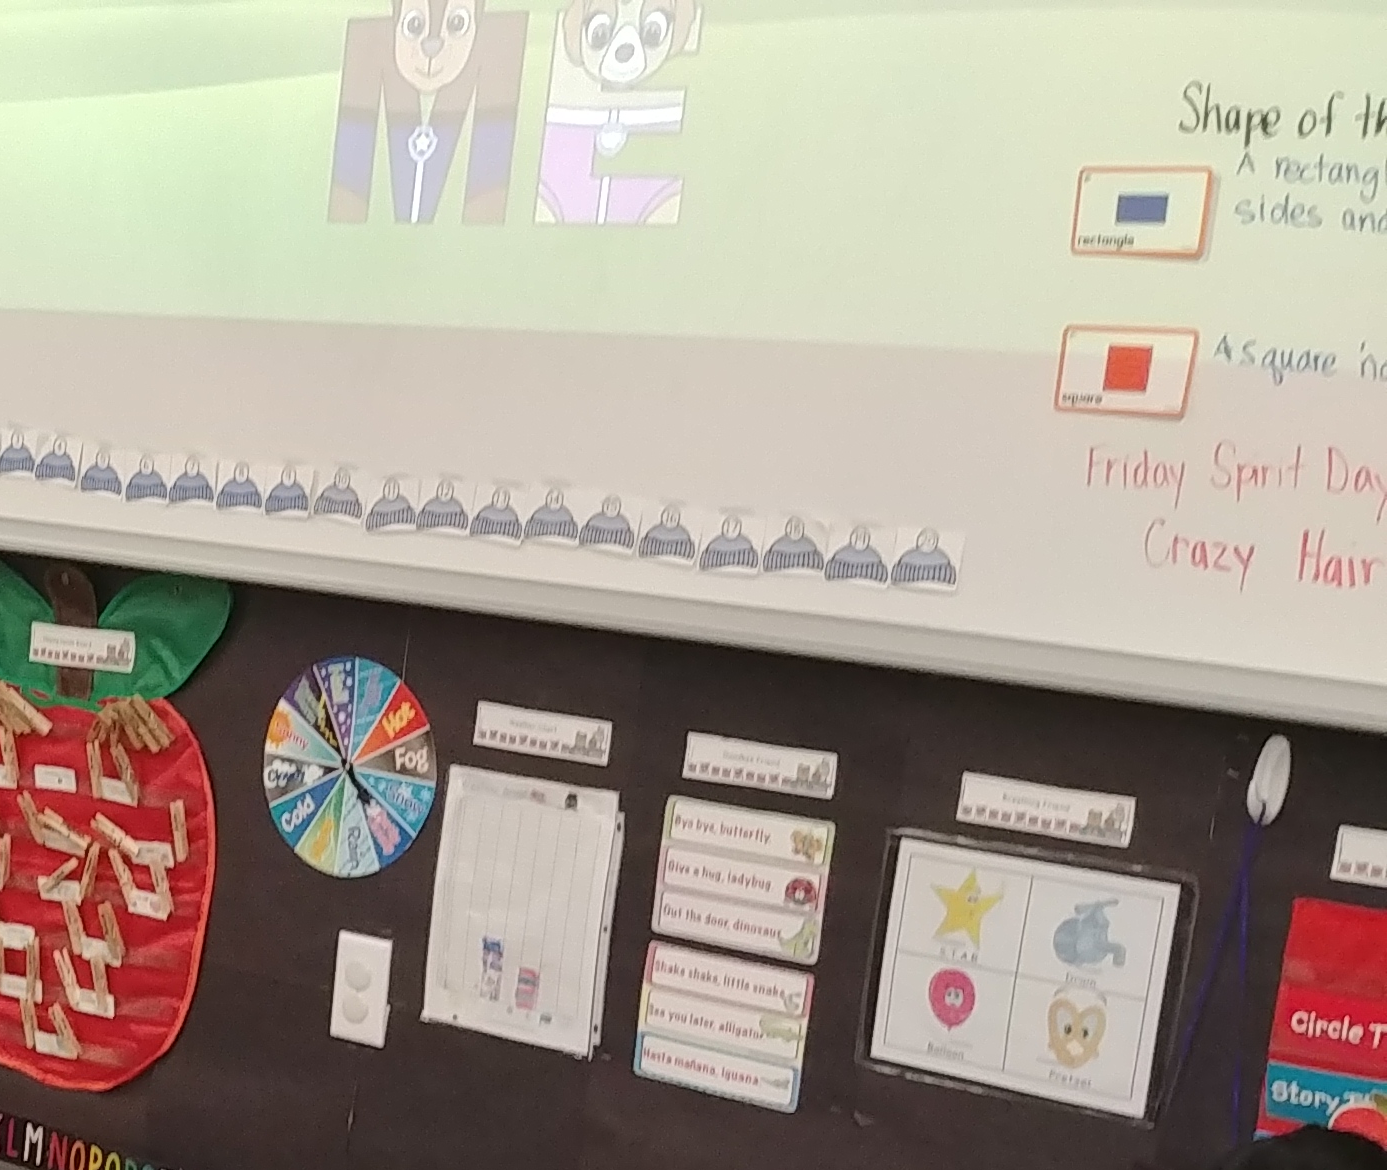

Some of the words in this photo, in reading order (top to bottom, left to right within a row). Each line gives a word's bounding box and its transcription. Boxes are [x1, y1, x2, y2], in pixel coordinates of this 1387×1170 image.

[1178, 79, 1281, 150] Shape
[1297, 90, 1345, 139] of
[1236, 152, 1255, 175] A
[1234, 192, 1323, 228] sides
[1078, 234, 1134, 250] rectangle
[1214, 333, 1232, 362] A
[1240, 338, 1337, 387] square
[1062, 393, 1103, 406] square
[1086, 445, 1186, 510] Friday
[1327, 445, 1387, 526] Day
[1144, 517, 1255, 594] Crazy
[1297, 528, 1387, 589] Hair
[382, 701, 416, 740] Hot
[394, 746, 430, 774] Fog
[281, 793, 315, 833] Cold
[675, 814, 694, 831] Bye
[668, 859, 690, 875] Give
[693, 867, 699, 877] a
[663, 902, 682, 919] Out
[685, 908, 702, 923] the
[654, 959, 685, 979] Shake
[723, 974, 750, 992] little
[649, 1002, 665, 1018] See
[669, 1010, 688, 1027] you
[1290, 1010, 1364, 1046] Circle
[643, 1047, 672, 1065] Hasta
[1271, 1080, 1341, 1116] Story
